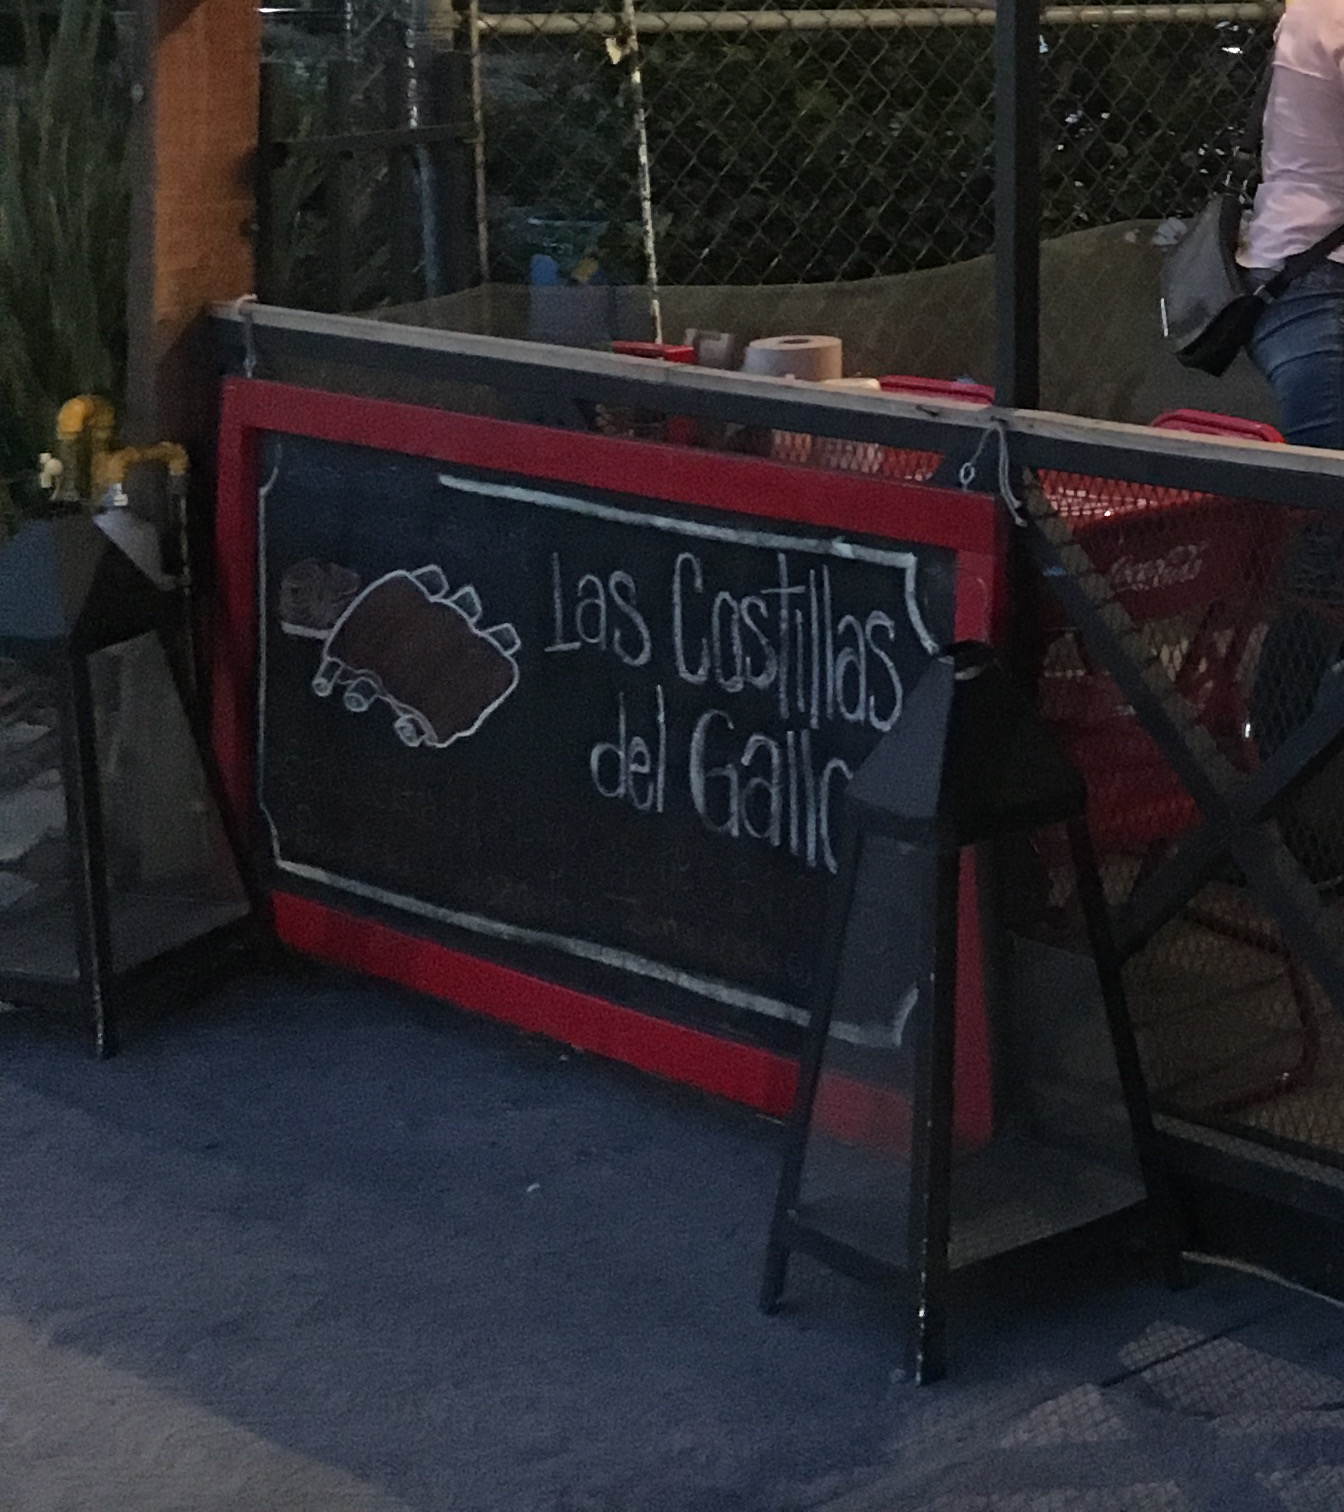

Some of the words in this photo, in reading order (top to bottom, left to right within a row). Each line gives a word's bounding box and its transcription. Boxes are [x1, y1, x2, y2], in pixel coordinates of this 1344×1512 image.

[544, 551, 652, 667] Las
[673, 551, 903, 732] Costillas
[590, 684, 666, 814] del
